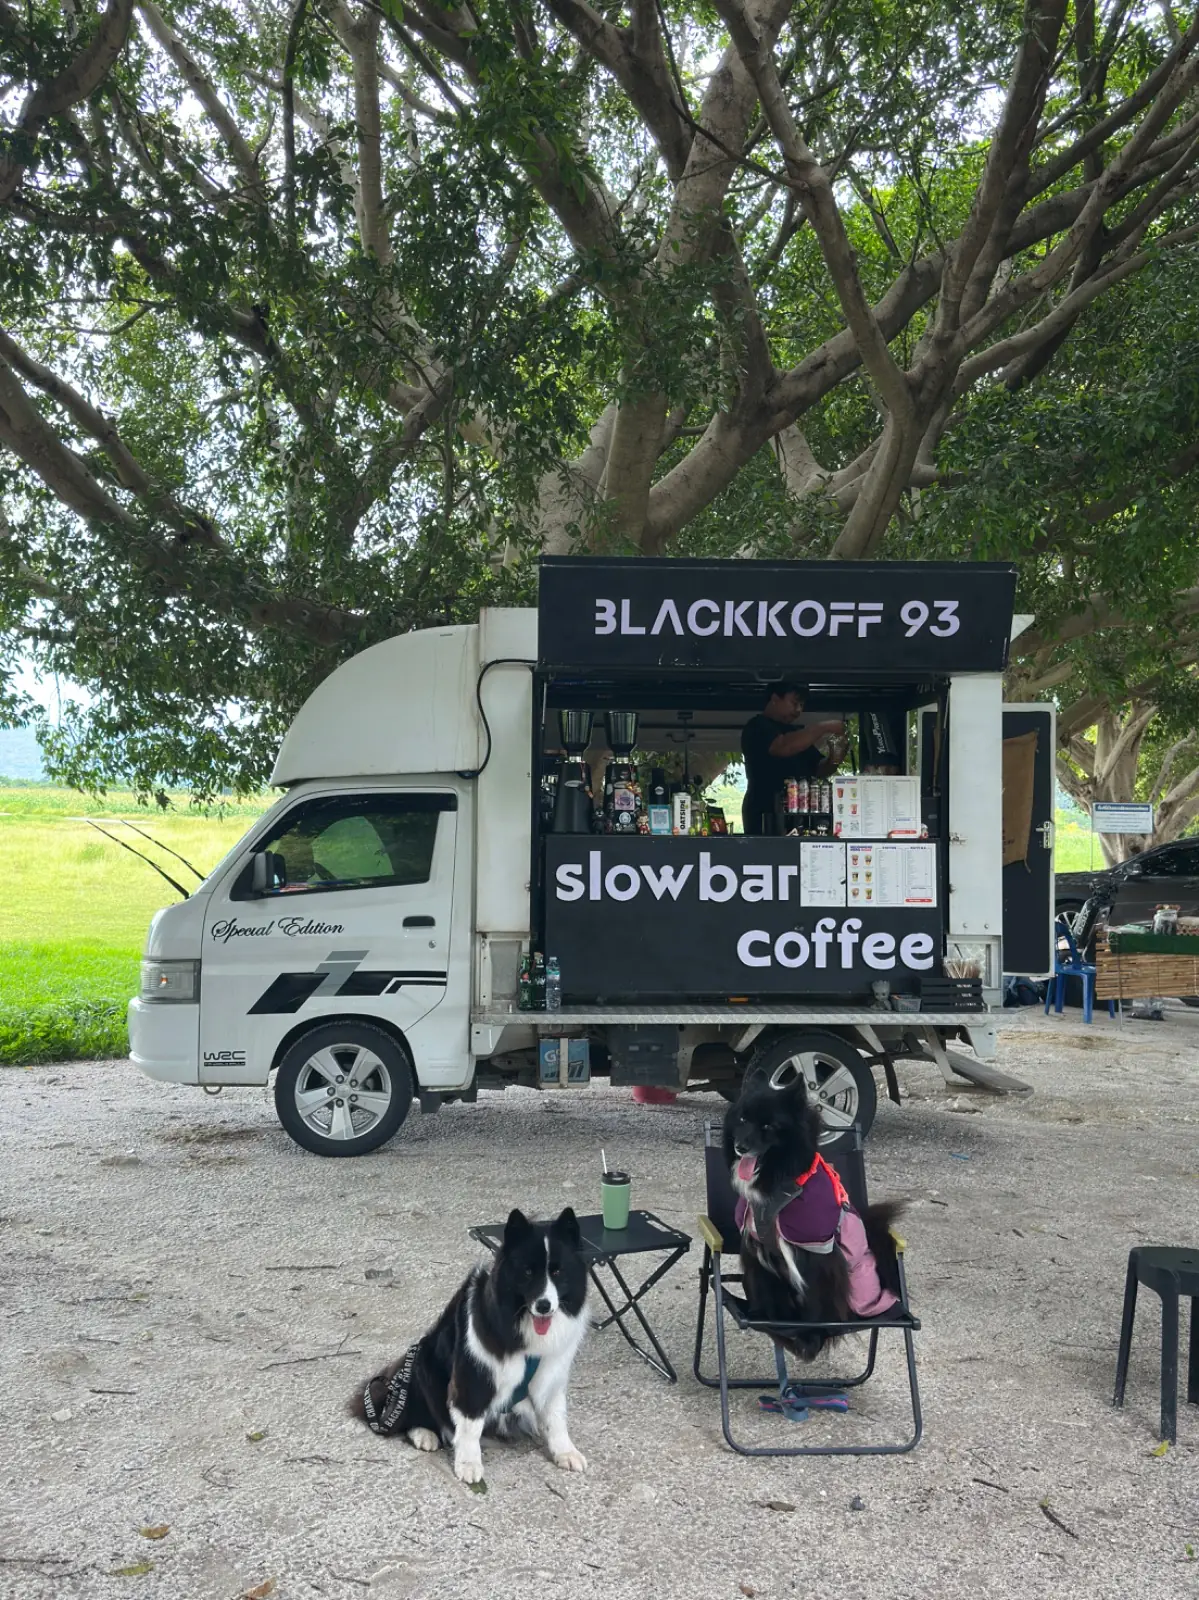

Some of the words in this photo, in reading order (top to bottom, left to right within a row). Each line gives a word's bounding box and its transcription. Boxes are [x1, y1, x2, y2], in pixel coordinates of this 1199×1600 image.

[595, 599, 884, 637] BLACKKOFF
[900, 600, 960, 637] 93
[211, 917, 276, 944] Special
[277, 917, 345, 937] Edition
[737, 917, 934, 970] coffee
[203, 1050, 246, 1061] WRC
[384, 1388, 408, 1427] BACKYARD
